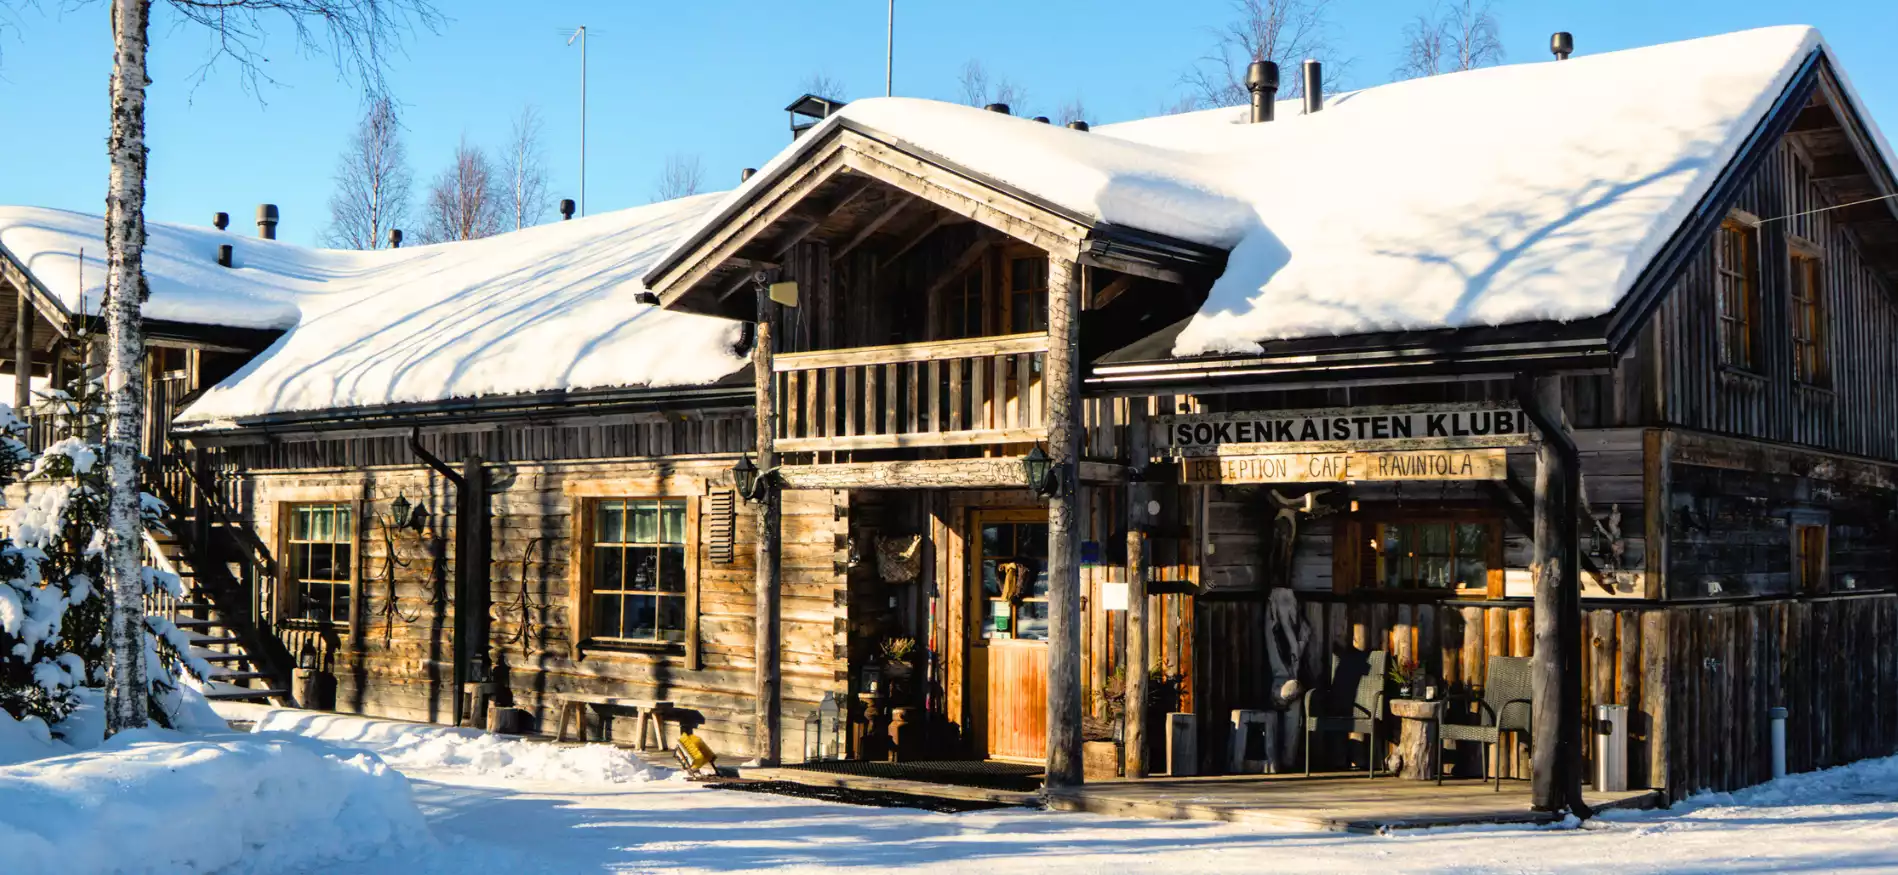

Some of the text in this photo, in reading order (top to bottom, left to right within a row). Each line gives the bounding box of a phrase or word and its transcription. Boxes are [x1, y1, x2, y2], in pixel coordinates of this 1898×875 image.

[1167, 411, 1525, 446] ISOKENKÄISTEN KLUBI
[1195, 453, 1473, 481] RECEPTION CAFE RAVINTOLA
